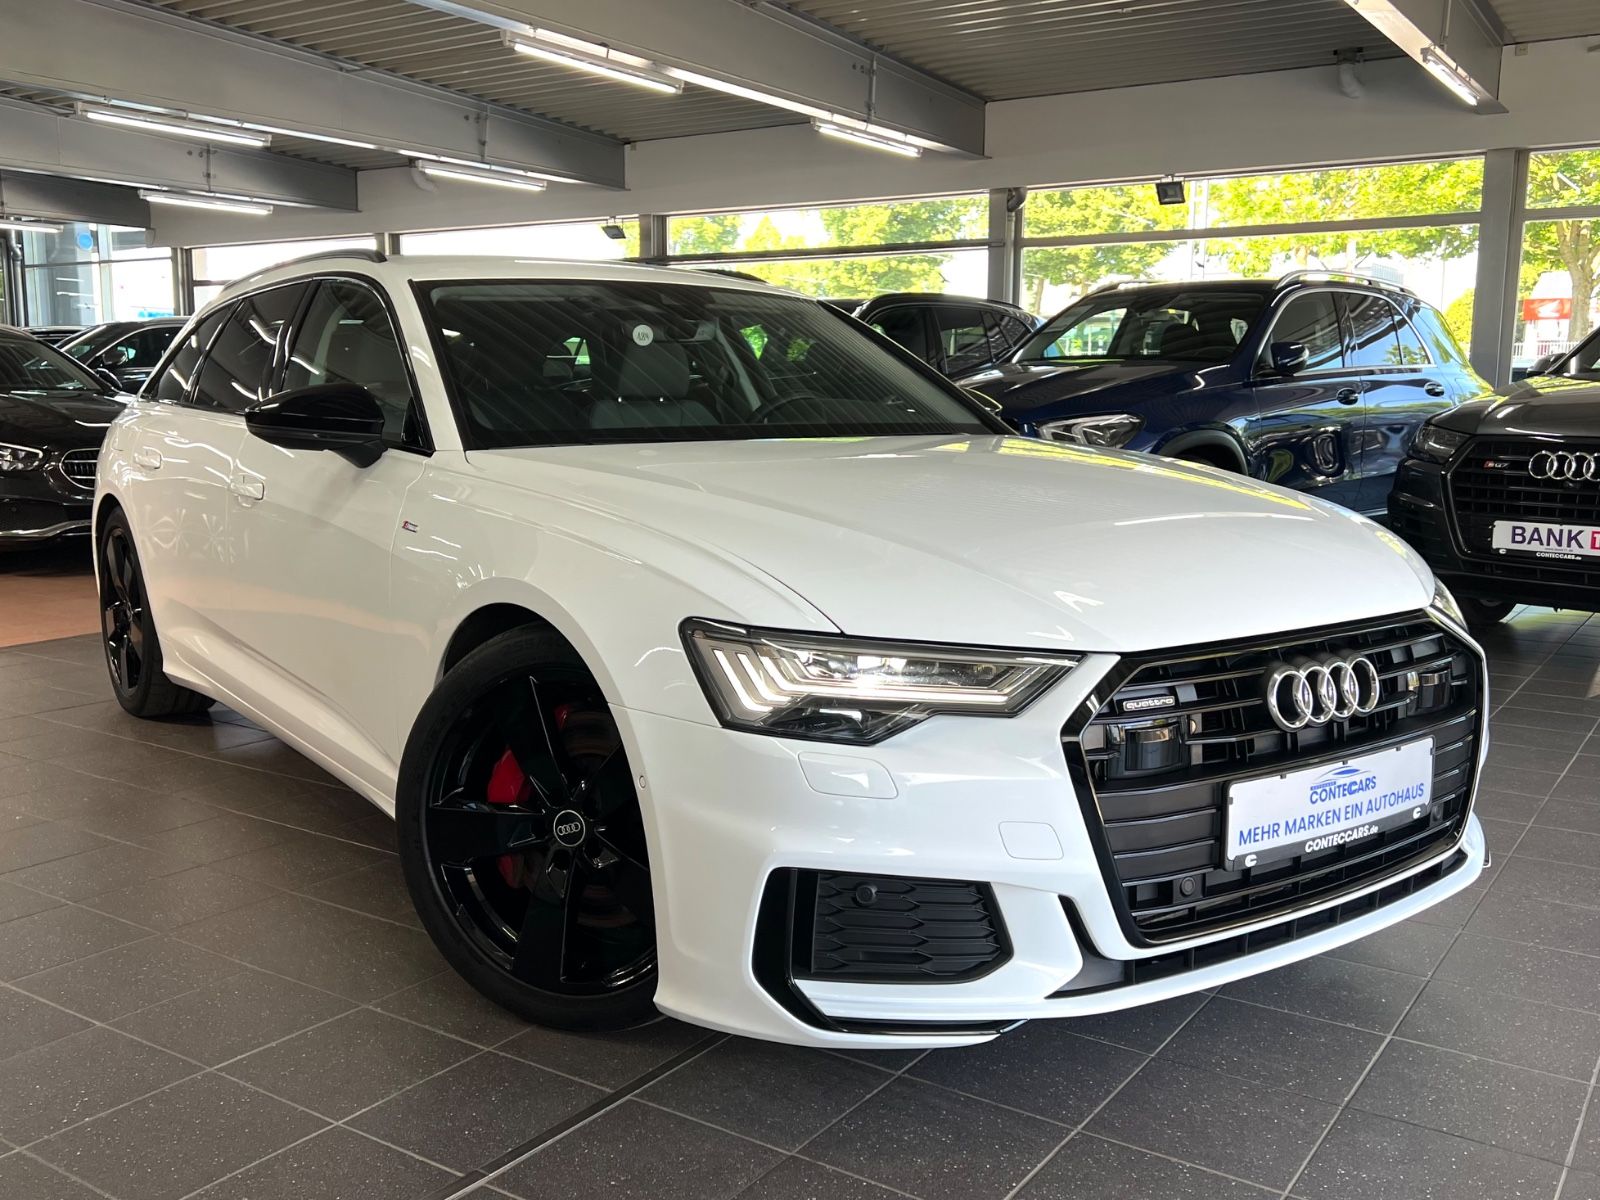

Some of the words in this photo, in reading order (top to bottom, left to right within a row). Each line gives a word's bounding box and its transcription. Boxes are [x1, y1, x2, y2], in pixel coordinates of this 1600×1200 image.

[1125, 697, 1174, 711] quattro
[1239, 822, 1280, 846] MEHR
[1284, 807, 1341, 836] MARKEN
[1344, 803, 1363, 821] EIN
[1366, 782, 1424, 815] AUTOHAUS
[1304, 825, 1379, 853] CONTECCARS.de
